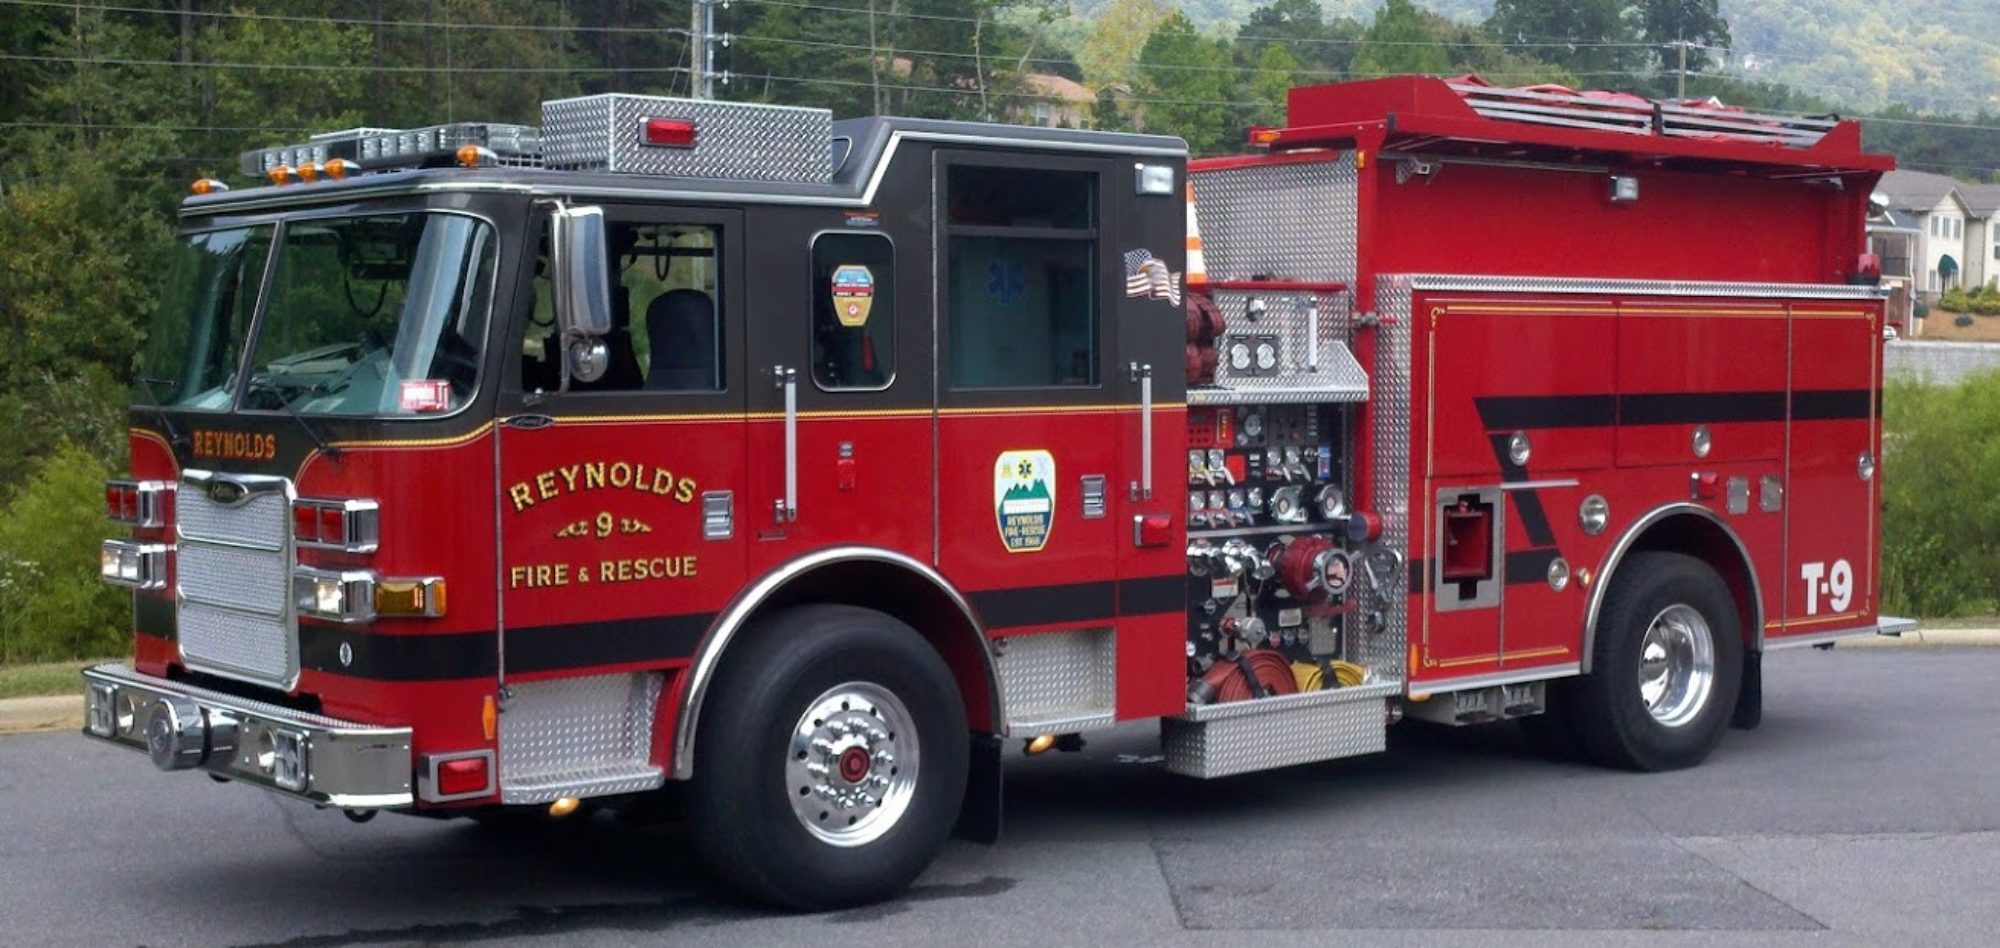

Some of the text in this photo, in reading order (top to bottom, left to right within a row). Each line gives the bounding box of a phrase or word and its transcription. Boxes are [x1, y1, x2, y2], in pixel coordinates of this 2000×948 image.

[192, 430, 276, 459] REYNOLDS
[509, 461, 697, 512] REYNOLDS
[596, 512, 613, 537] 9
[511, 556, 697, 588] FIRE & RESCUE
[1801, 559, 1853, 615] T-9
